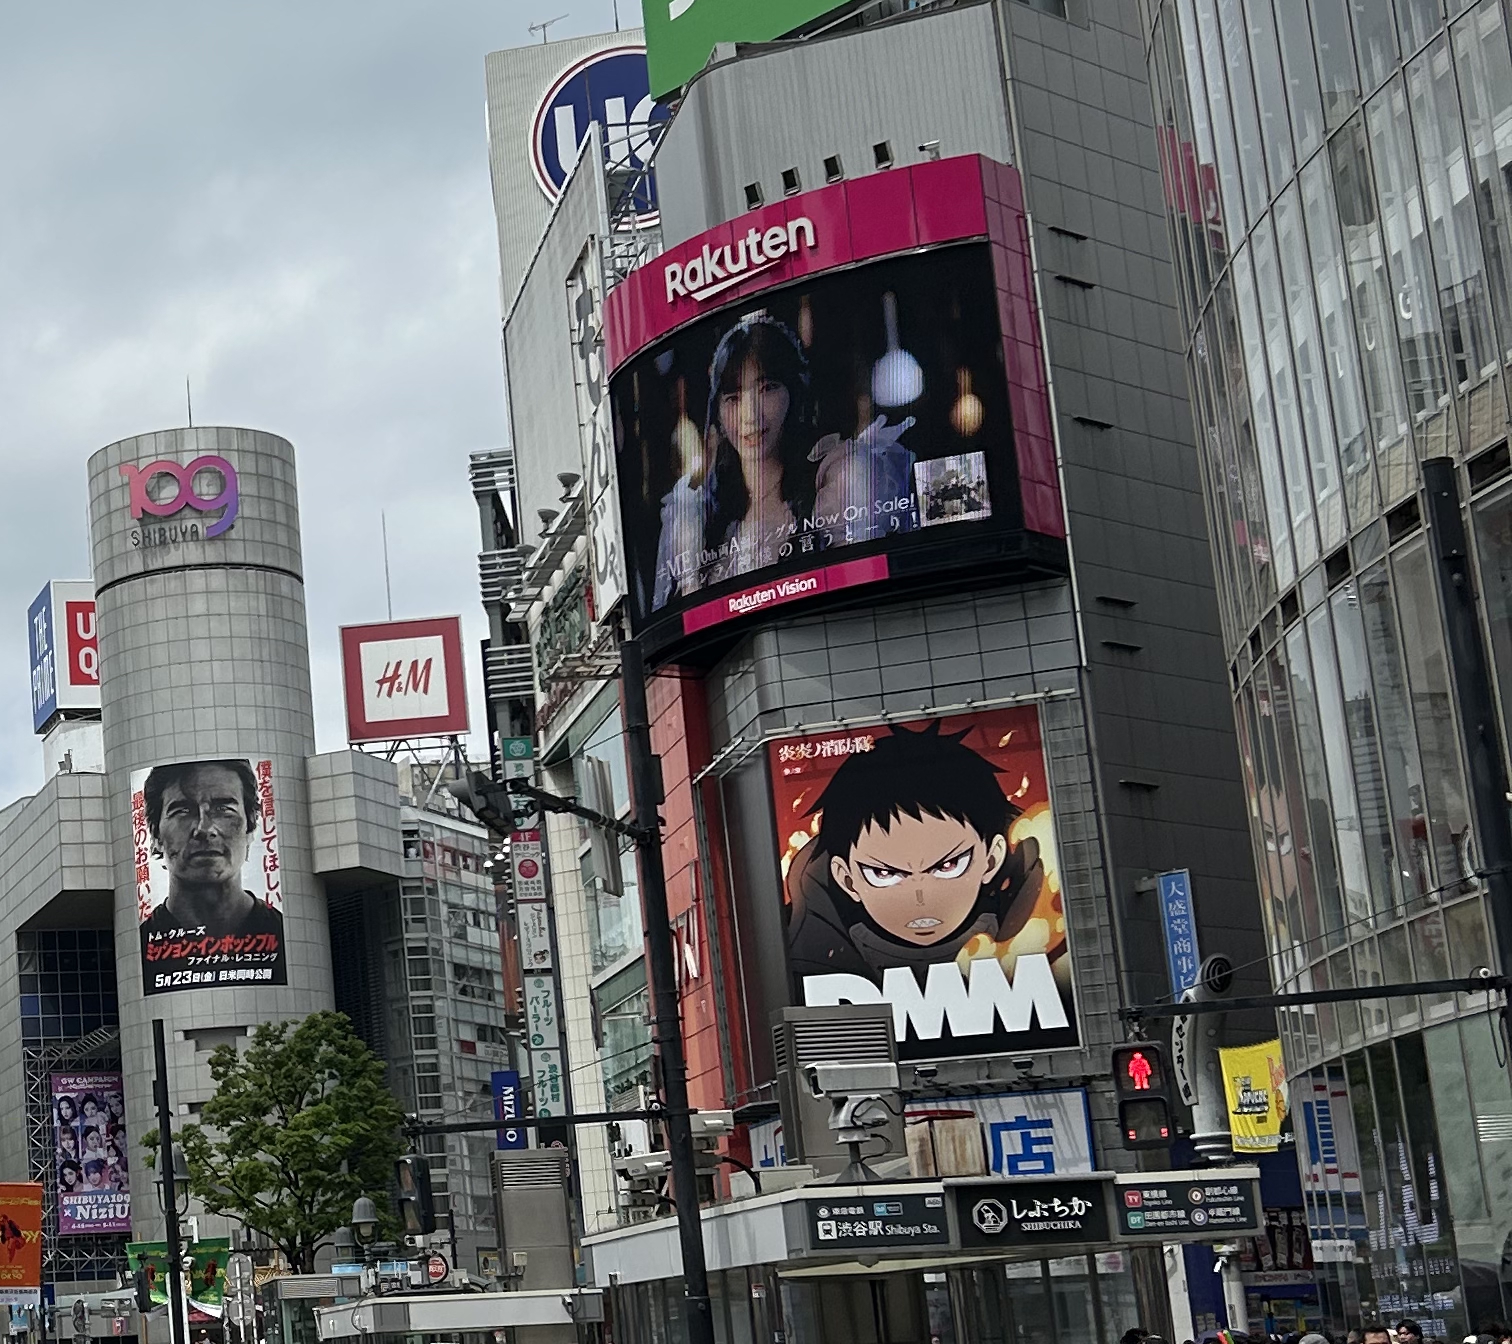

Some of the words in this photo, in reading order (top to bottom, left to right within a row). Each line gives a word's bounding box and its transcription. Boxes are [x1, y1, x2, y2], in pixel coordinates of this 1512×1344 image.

[664, 214, 816, 303] Rakuten
[120, 455, 237, 537] 109
[131, 523, 199, 546] SHIBUYA
[803, 513, 839, 531] Now
[844, 505, 868, 520] On
[728, 588, 775, 613] Rakuten
[777, 575, 817, 596] Vision
[376, 656, 433, 699] H&M
[256, 760, 281, 909] 僕を信じてほしい
[132, 790, 153, 921] 最後のお願いだ
[148, 926, 206, 942] トム・クルーズ
[1166, 878, 1195, 990] 大盛堂商事ビ
[155, 968, 215, 988] 5月23日(金)
[803, 953, 1069, 1041] DMM
[502, 1086, 518, 1142] MIZUO
[990, 1113, 1054, 1175] 店
[75, 1204, 130, 1220] NiziU
[1010, 1197, 1091, 1219] しぶちか
[1021, 1220, 1082, 1231] SHIBUCHIKA
[837, 1221, 885, 1237] 渋谷駅
